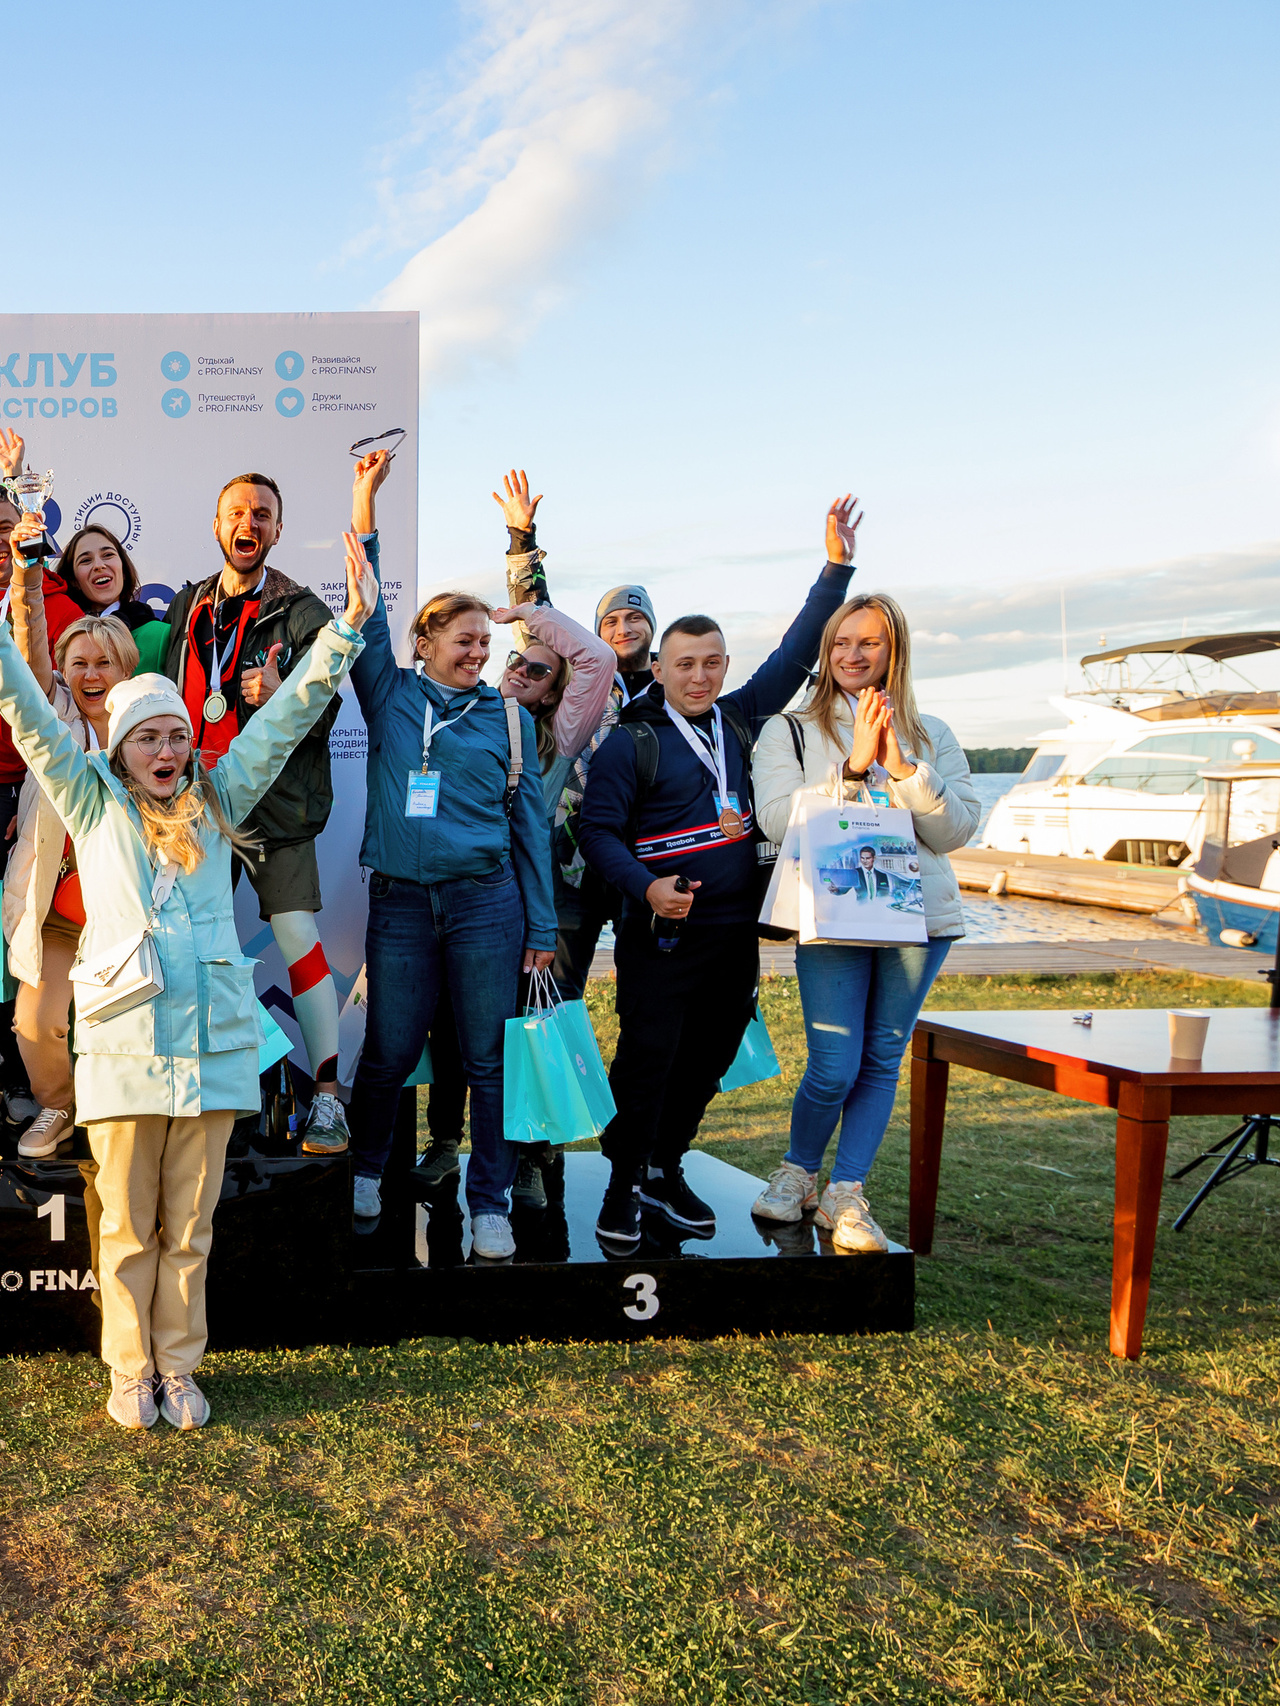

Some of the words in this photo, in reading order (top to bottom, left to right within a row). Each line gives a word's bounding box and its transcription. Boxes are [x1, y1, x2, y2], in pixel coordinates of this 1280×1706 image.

[197, 356, 235, 366] Отдыхай
[311, 355, 361, 364] Развивайся
[205, 367, 264, 376] PRO.FINANSY
[319, 366, 377, 375] PRO.FINANSY
[198, 393, 256, 403] Путешествуй
[311, 392, 342, 402] Дружи
[205, 404, 264, 413] PRO.FINANSY
[319, 403, 377, 412] PRO.FINANSY
[73, 492, 103, 531] СТИЦИИ
[105, 491, 142, 542] ДОСТУПНЫ
[380, 581, 403, 590] ЛУБ
[330, 729, 368, 737] КРЫТЫ
[330, 751, 369, 760] ИНВЕСТ
[665, 836, 696, 848] Reebok
[37, 1194, 65, 1241] 1
[29, 1268, 100, 1291] FINA
[622, 1273, 660, 1320] 3
